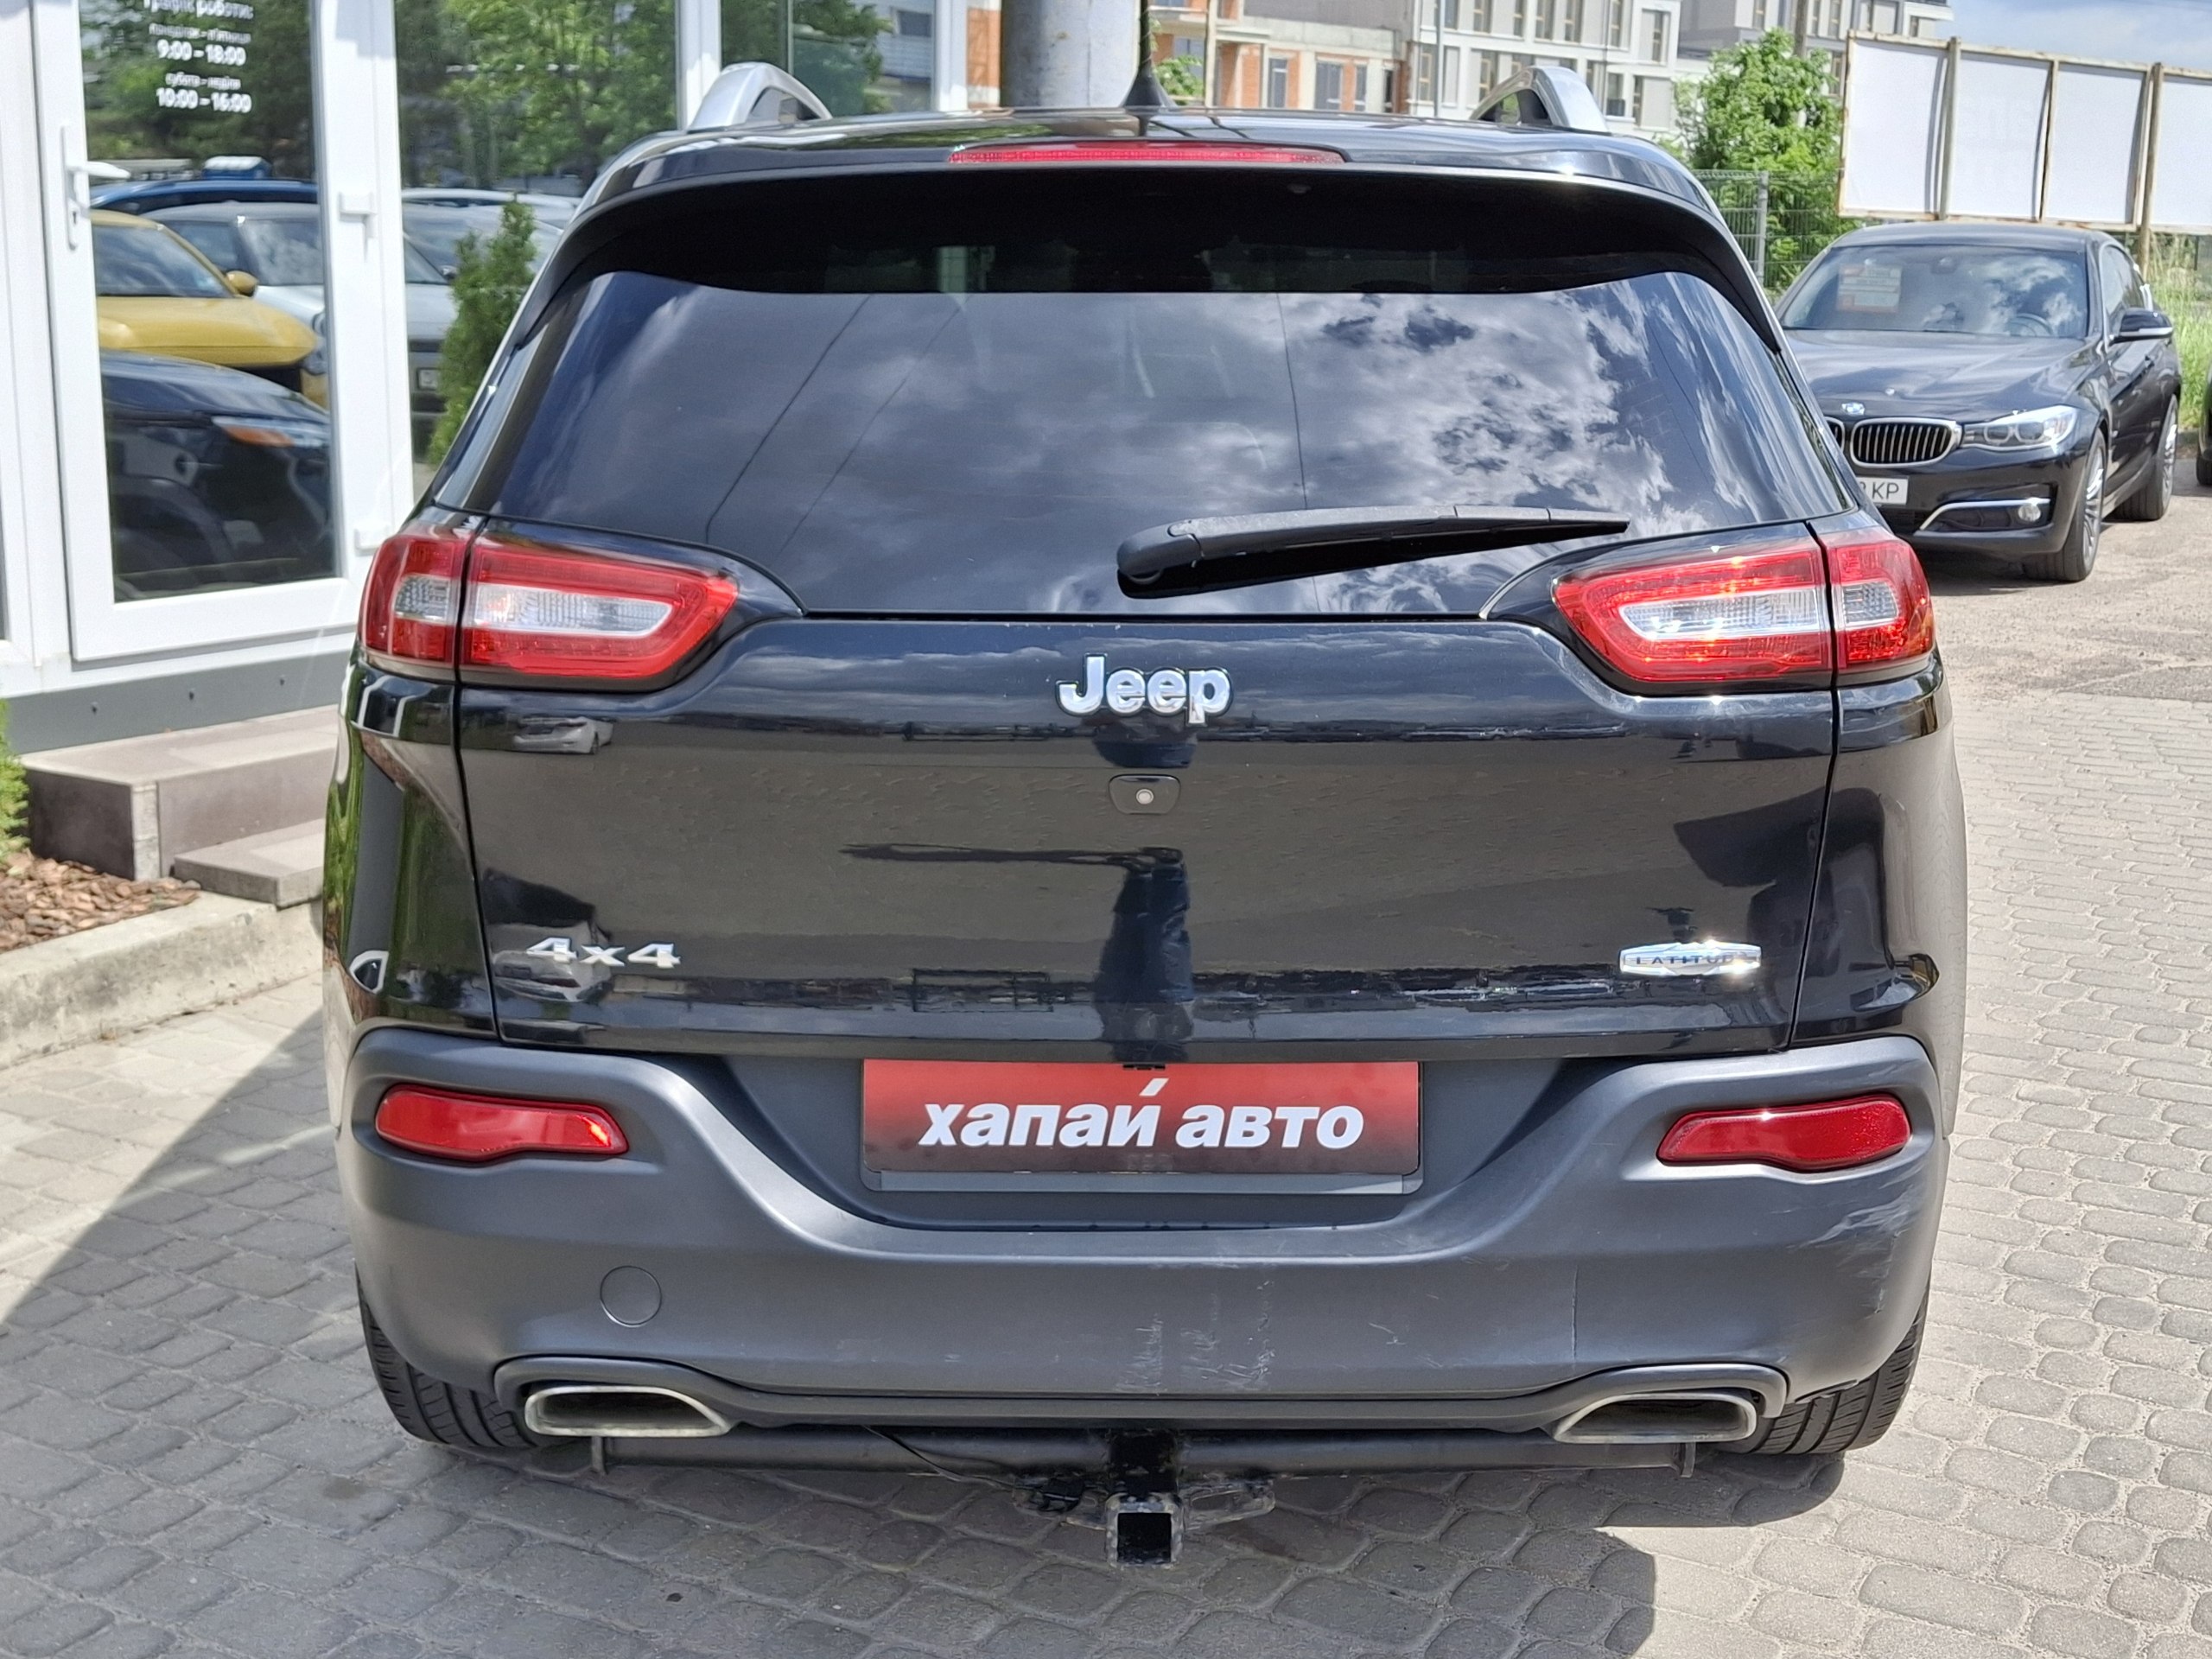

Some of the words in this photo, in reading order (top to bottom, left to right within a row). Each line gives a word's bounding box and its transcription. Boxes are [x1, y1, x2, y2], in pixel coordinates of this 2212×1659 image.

[157, 39, 193, 60] 9:00
[206, 44, 246, 66] 18:00
[156, 87, 199, 109] 10:00
[211, 92, 251, 113] 16:00
[1056, 652, 1232, 726] Jeep
[526, 937, 681, 969] 4x4
[1636, 954, 1747, 966] LATITUD
[1176, 1104, 1364, 1148] авто
